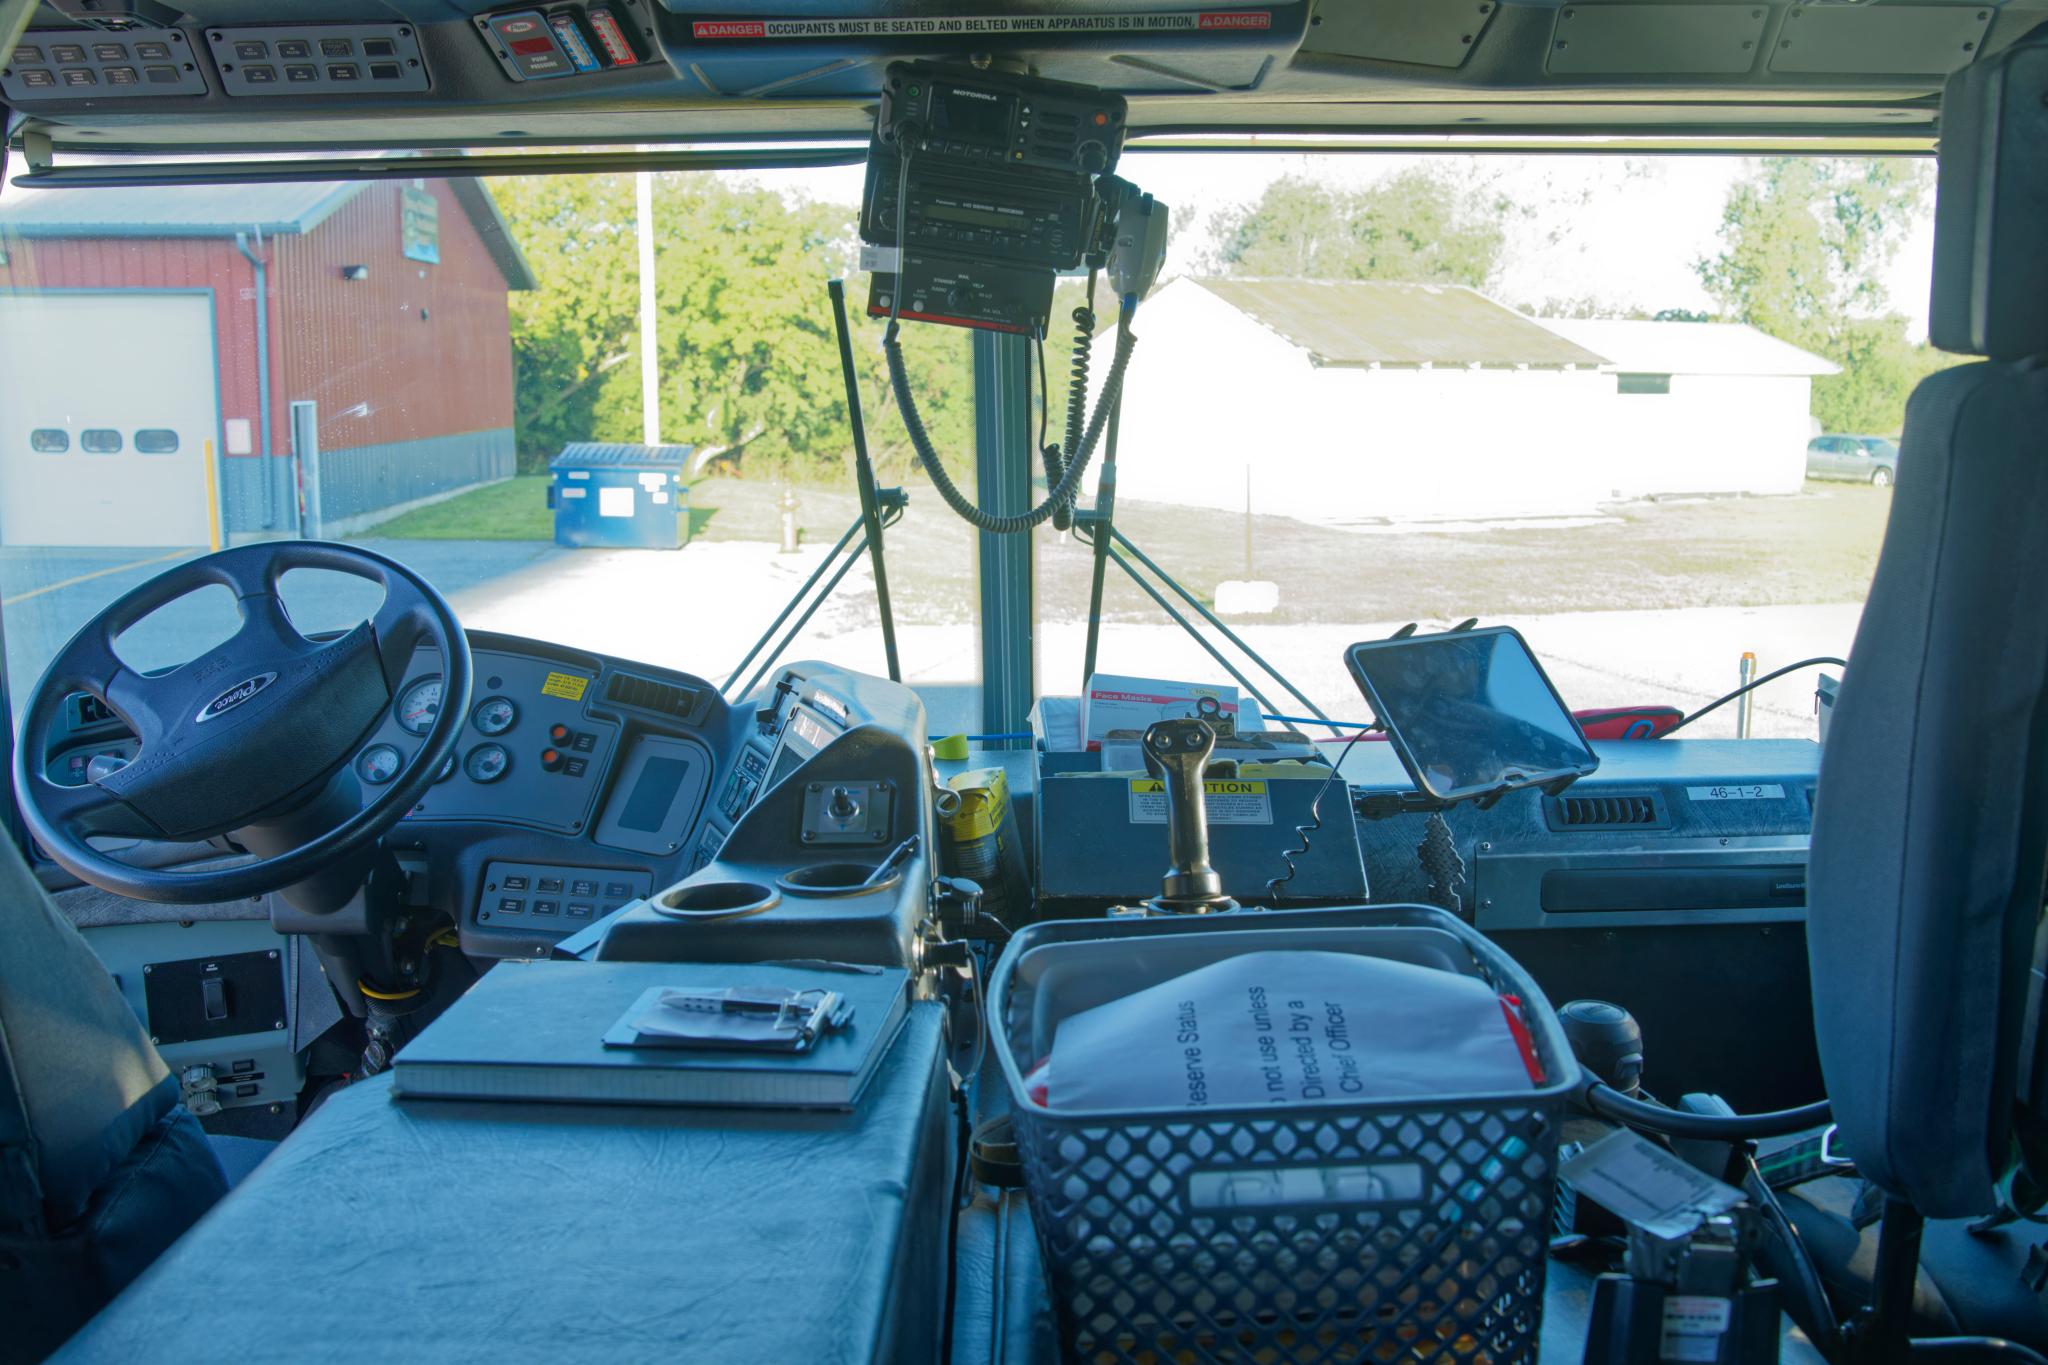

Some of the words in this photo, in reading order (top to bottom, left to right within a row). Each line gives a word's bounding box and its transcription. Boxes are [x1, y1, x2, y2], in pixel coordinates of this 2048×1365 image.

[709, 24, 763, 36] DANGER
[768, 22, 836, 35] OCCUPANTS
[838, 21, 871, 34] MUST
[873, 21, 889, 33] BE
[891, 20, 935, 33] SEATED
[938, 20, 963, 32] AND
[965, 19, 1008, 32] BELTED
[1011, 18, 1045, 30] WHEN
[1048, 17, 1116, 30] APPARATUS
[1118, 17, 1130, 29] IS
[1132, 17, 1145, 28] IN
[1213, 15, 1268, 26] DANGER
[953, 88, 998, 102] MOTOROLA
[1095, 691, 1119, 701] Face
[1121, 694, 1153, 702] Masks
[1710, 786, 1764, 799] 46-1-2
[1248, 986, 1272, 1032] unless
[1288, 1000, 1305, 1010] a
[1176, 1000, 1199, 1044] Status
[1288, 1012, 1314, 1033] by
[1324, 1001, 1351, 1052] Officer
[1258, 1035, 1279, 1062] use
[1290, 1036, 1326, 1100] Directed
[1331, 1053, 1364, 1094] Chief
[1260, 1065, 1286, 1093] not
